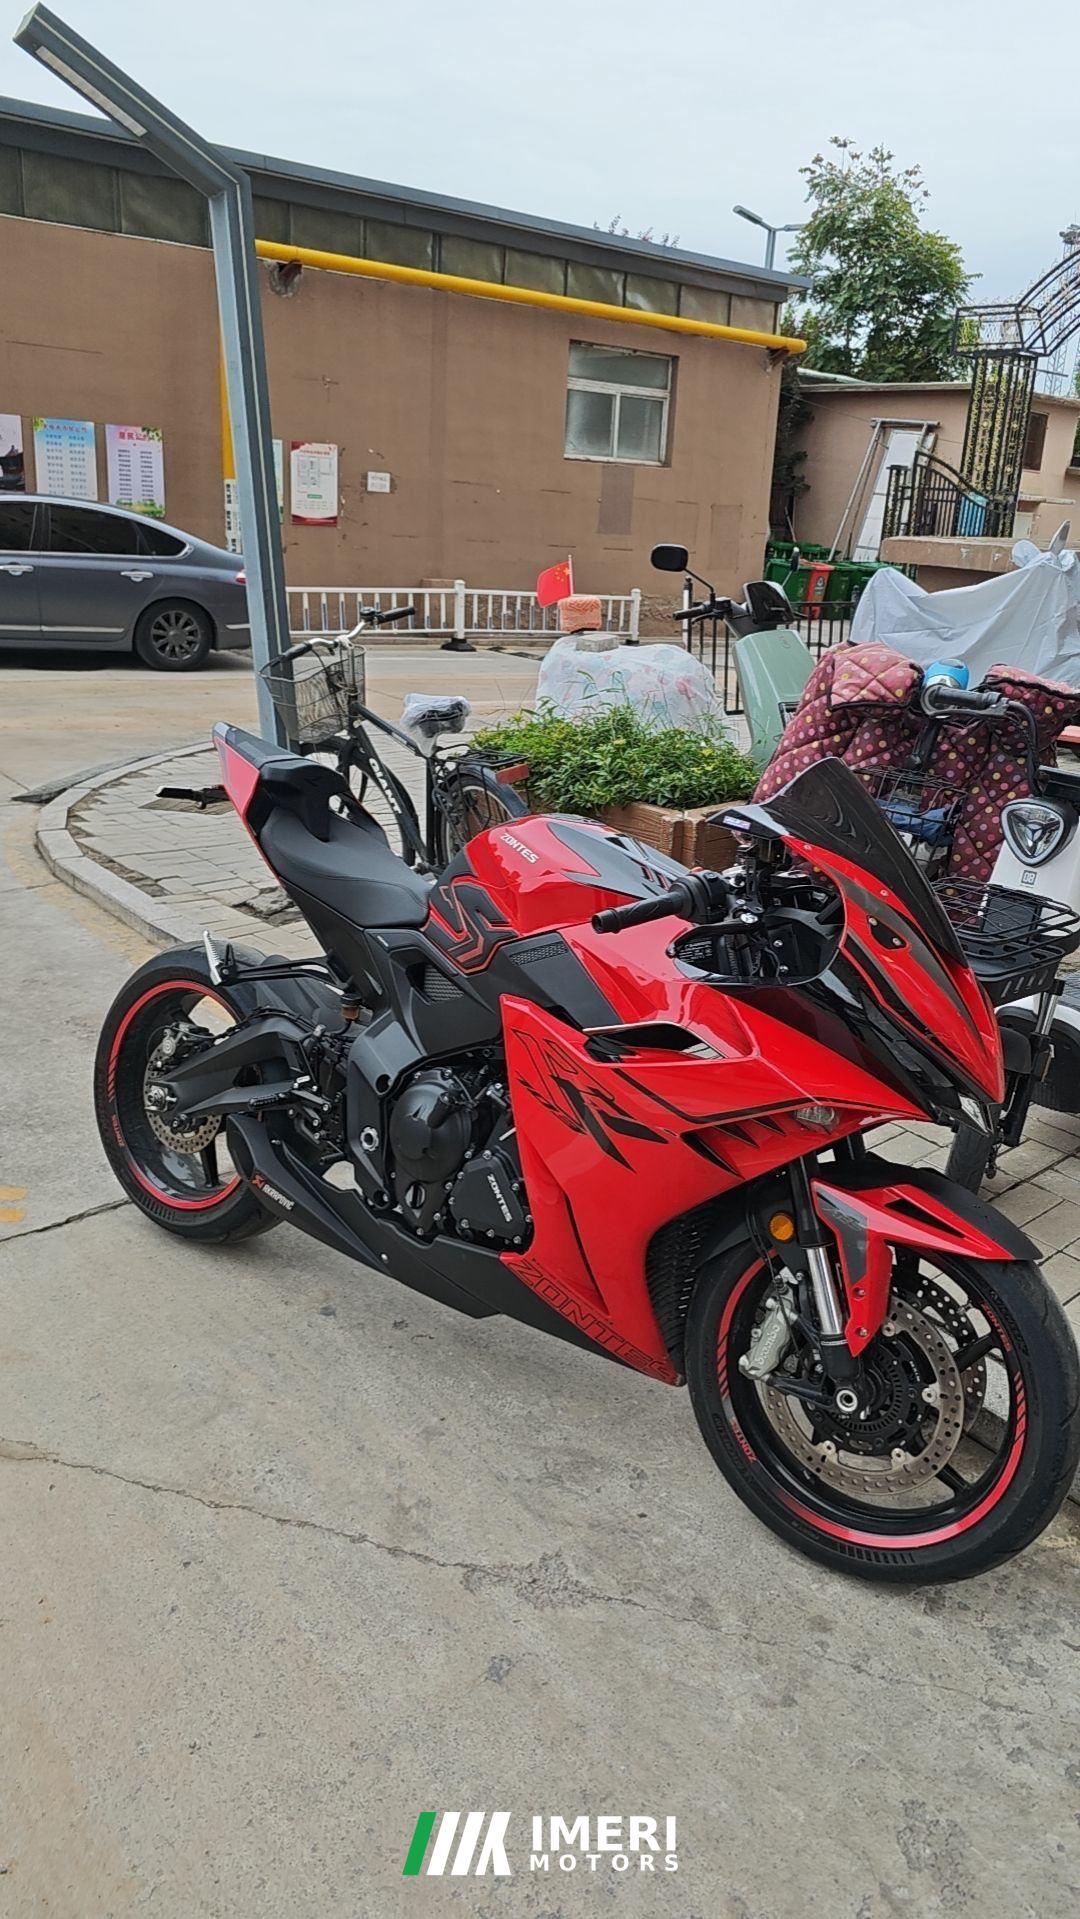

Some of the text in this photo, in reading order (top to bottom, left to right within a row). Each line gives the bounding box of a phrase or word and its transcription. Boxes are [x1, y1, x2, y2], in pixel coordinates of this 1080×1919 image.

[369, 758, 402, 814] GIANT
[501, 832, 540, 864] ZONTES
[487, 1174, 512, 1222] ZONTES
[507, 1258, 680, 1385] ZONTES
[981, 1302, 1012, 1352] ZONTES
